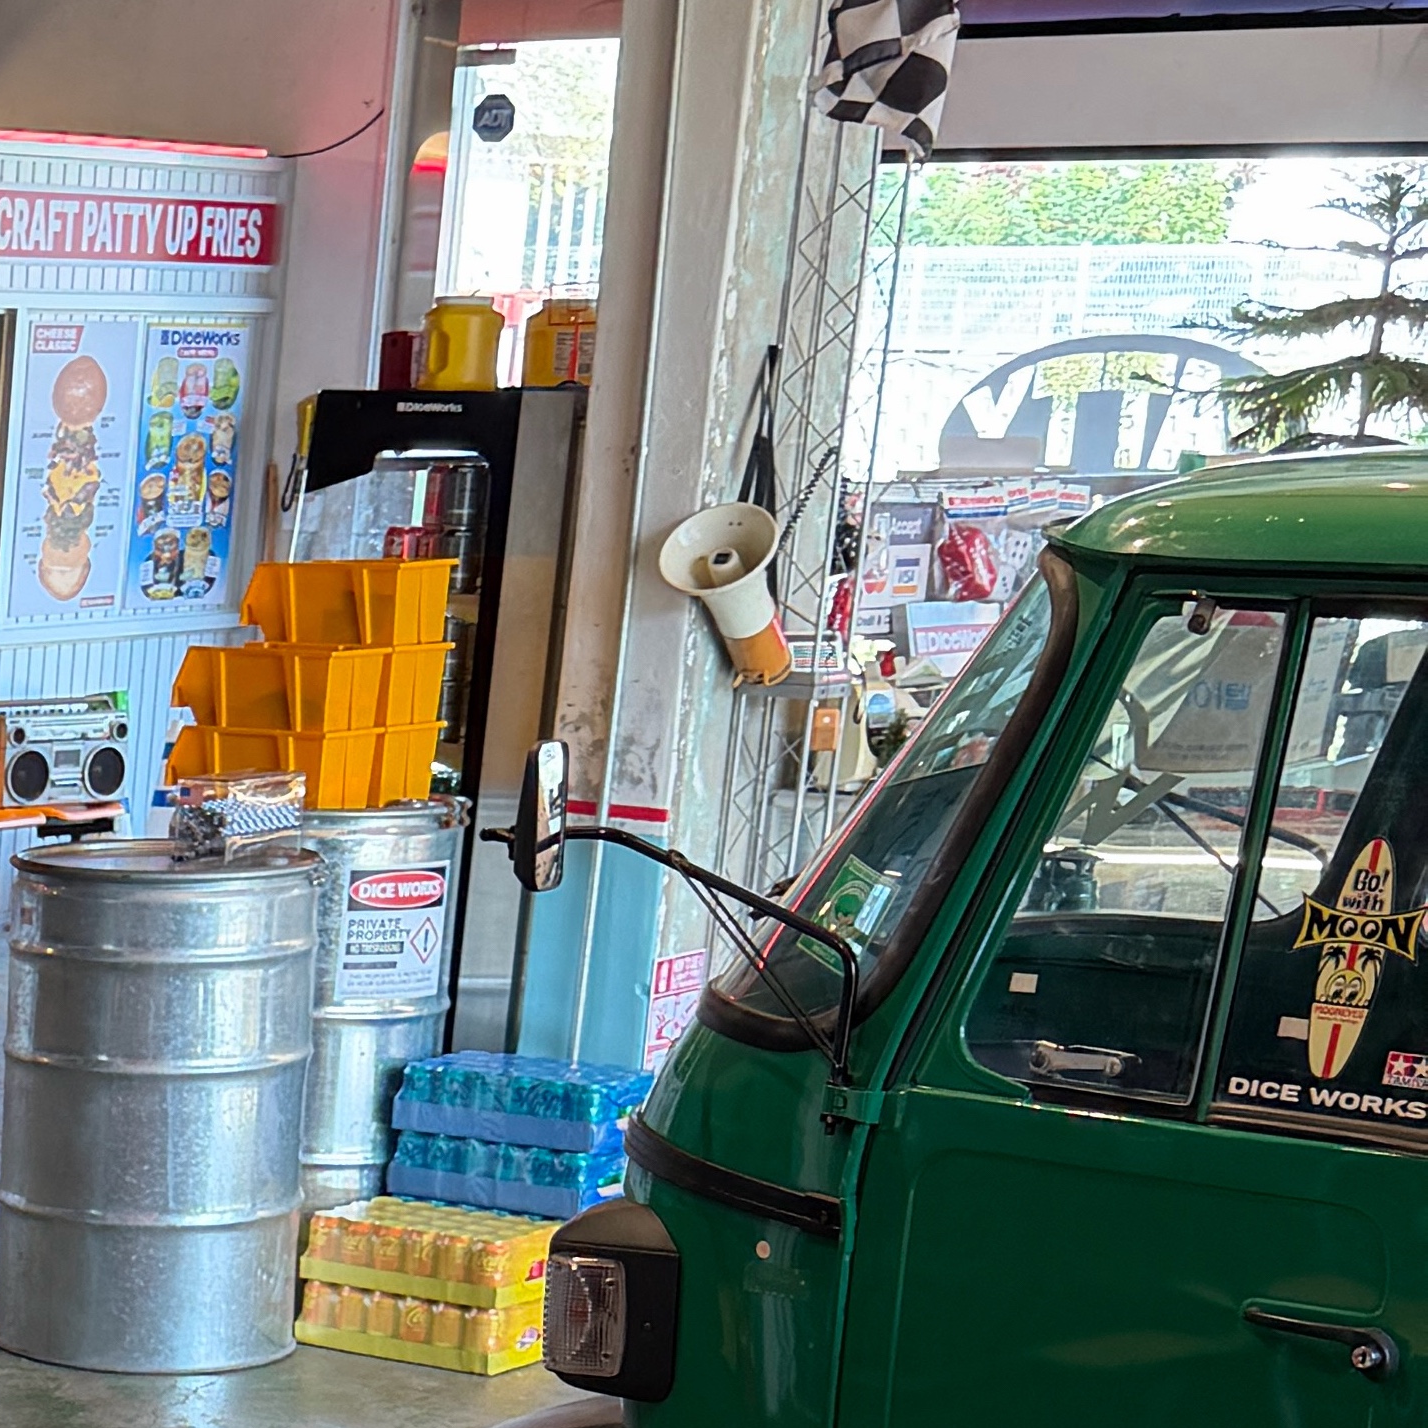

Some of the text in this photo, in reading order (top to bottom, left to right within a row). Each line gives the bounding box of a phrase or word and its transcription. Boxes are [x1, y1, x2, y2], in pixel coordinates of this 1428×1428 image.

[477, 109, 511, 127] ADT
[82, 201, 165, 255] PATTY
[165, 204, 196, 256] UP
[199, 207, 262, 258] FRIES
[171, 331, 240, 346] DiceWorks
[405, 402, 463, 413] DiceWorks
[358, 880, 441, 899] DICE WORKS
[1354, 869, 1389, 892] Go!
[1343, 895, 1384, 912] with
[348, 918, 402, 930] PRIVATE
[347, 928, 412, 941] PROPERTY
[1304, 911, 1417, 957] MOON
[1228, 1077, 1428, 1120] DICE WORKS
